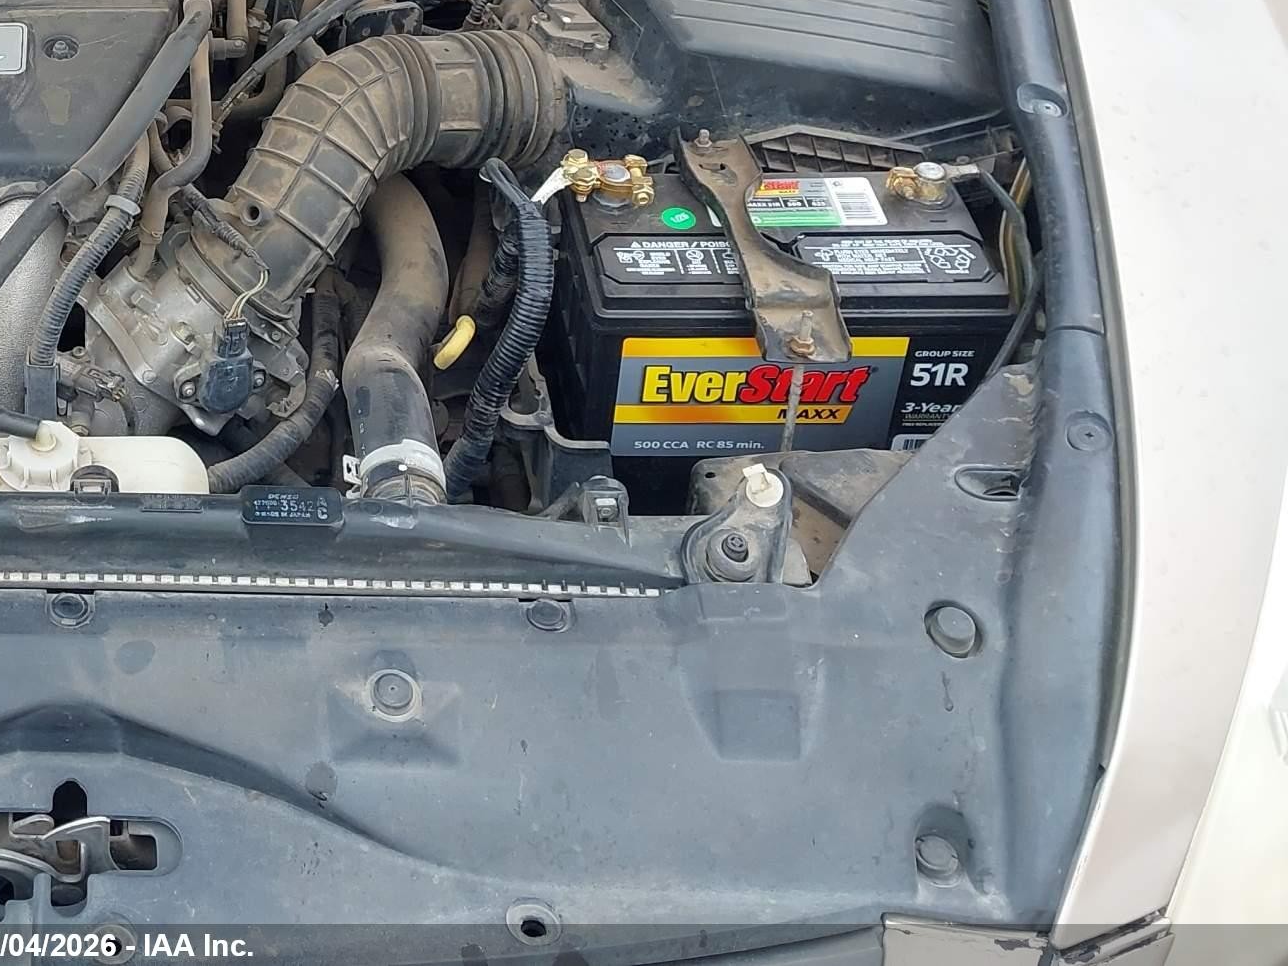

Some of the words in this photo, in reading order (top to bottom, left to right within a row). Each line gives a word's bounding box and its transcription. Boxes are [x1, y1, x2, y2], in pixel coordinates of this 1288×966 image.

[914, 350, 951, 358] GROUP
[951, 350, 975, 358] SIZE
[910, 362, 969, 387] 51R
[641, 364, 872, 404] EverStart
[900, 402, 962, 413] 3-Year
[634, 440, 661, 449] 500
[663, 440, 689, 449] CCA
[696, 440, 716, 449] RC
[717, 440, 734, 449] 85
[736, 440, 765, 449] min.
